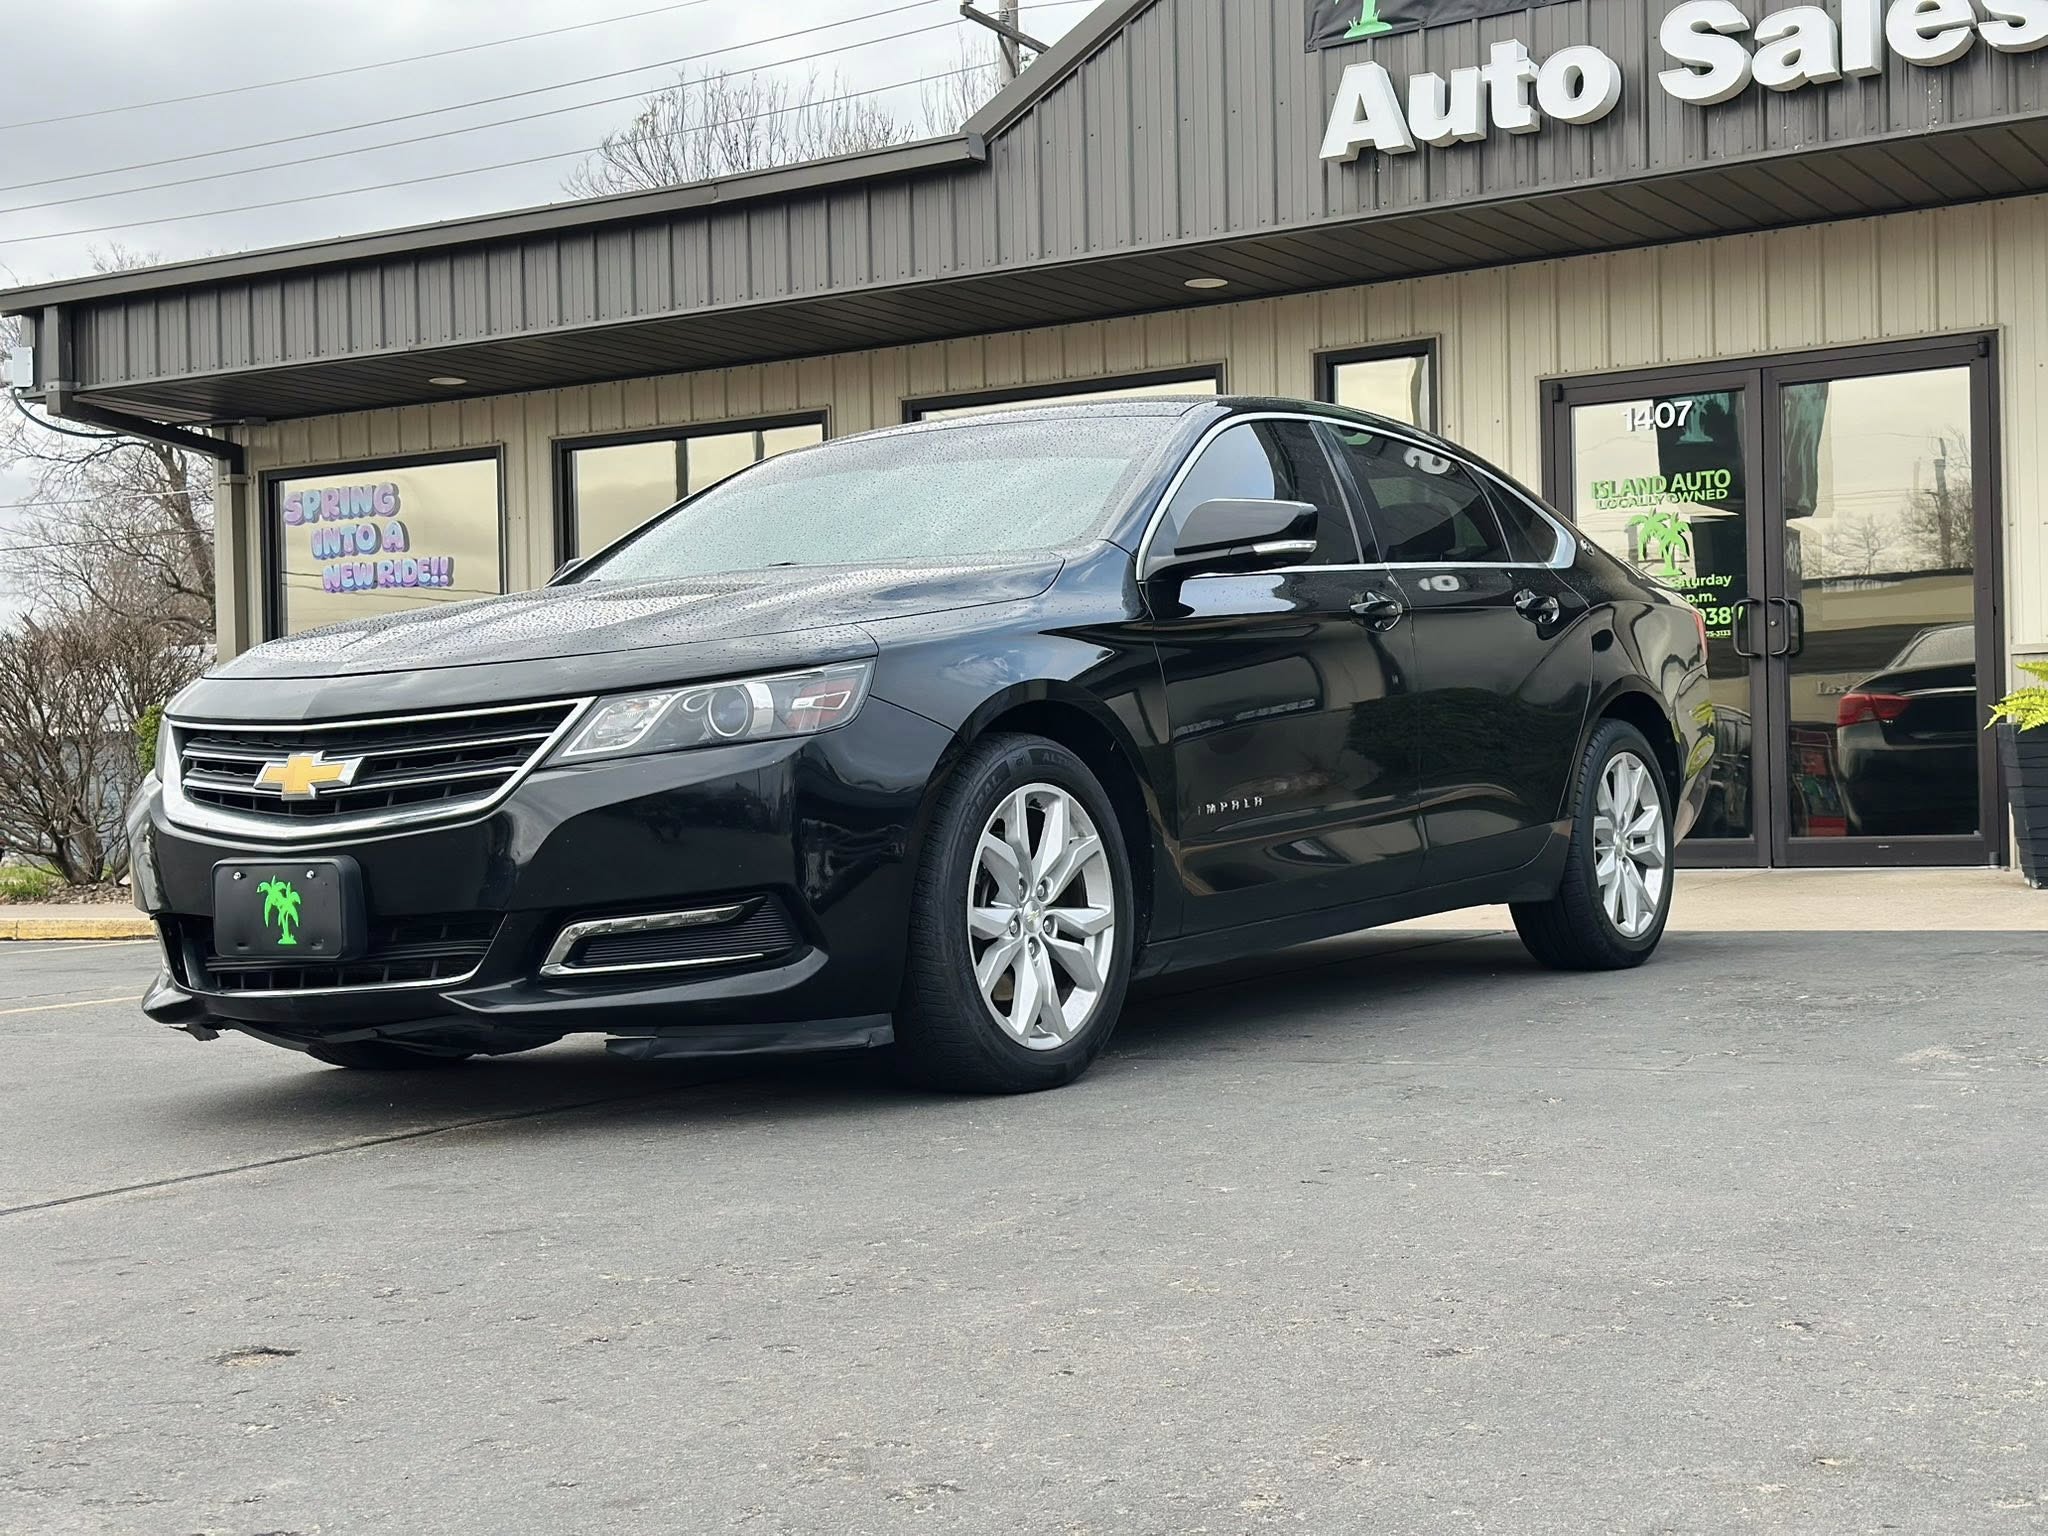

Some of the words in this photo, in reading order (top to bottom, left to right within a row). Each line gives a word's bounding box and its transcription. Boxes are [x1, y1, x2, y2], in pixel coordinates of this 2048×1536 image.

[1319, 39, 1621, 163] Auto
[1658, 0, 2048, 105] Sales
[1621, 401, 1693, 432] 1407
[1591, 475, 1667, 499] ISLAND
[1670, 469, 1731, 492] AUTO
[1597, 493, 1666, 509] LOCALLY
[1667, 489, 1728, 503] OWNED
[284, 482, 400, 526] SPRING
[311, 523, 381, 560] INTO
[381, 520, 410, 553] A
[322, 562, 376, 593] NEW
[376, 556, 454, 588] RIDE!!
[1686, 593, 1717, 605] p.m.
[1197, 796, 1263, 816] IMPALA
